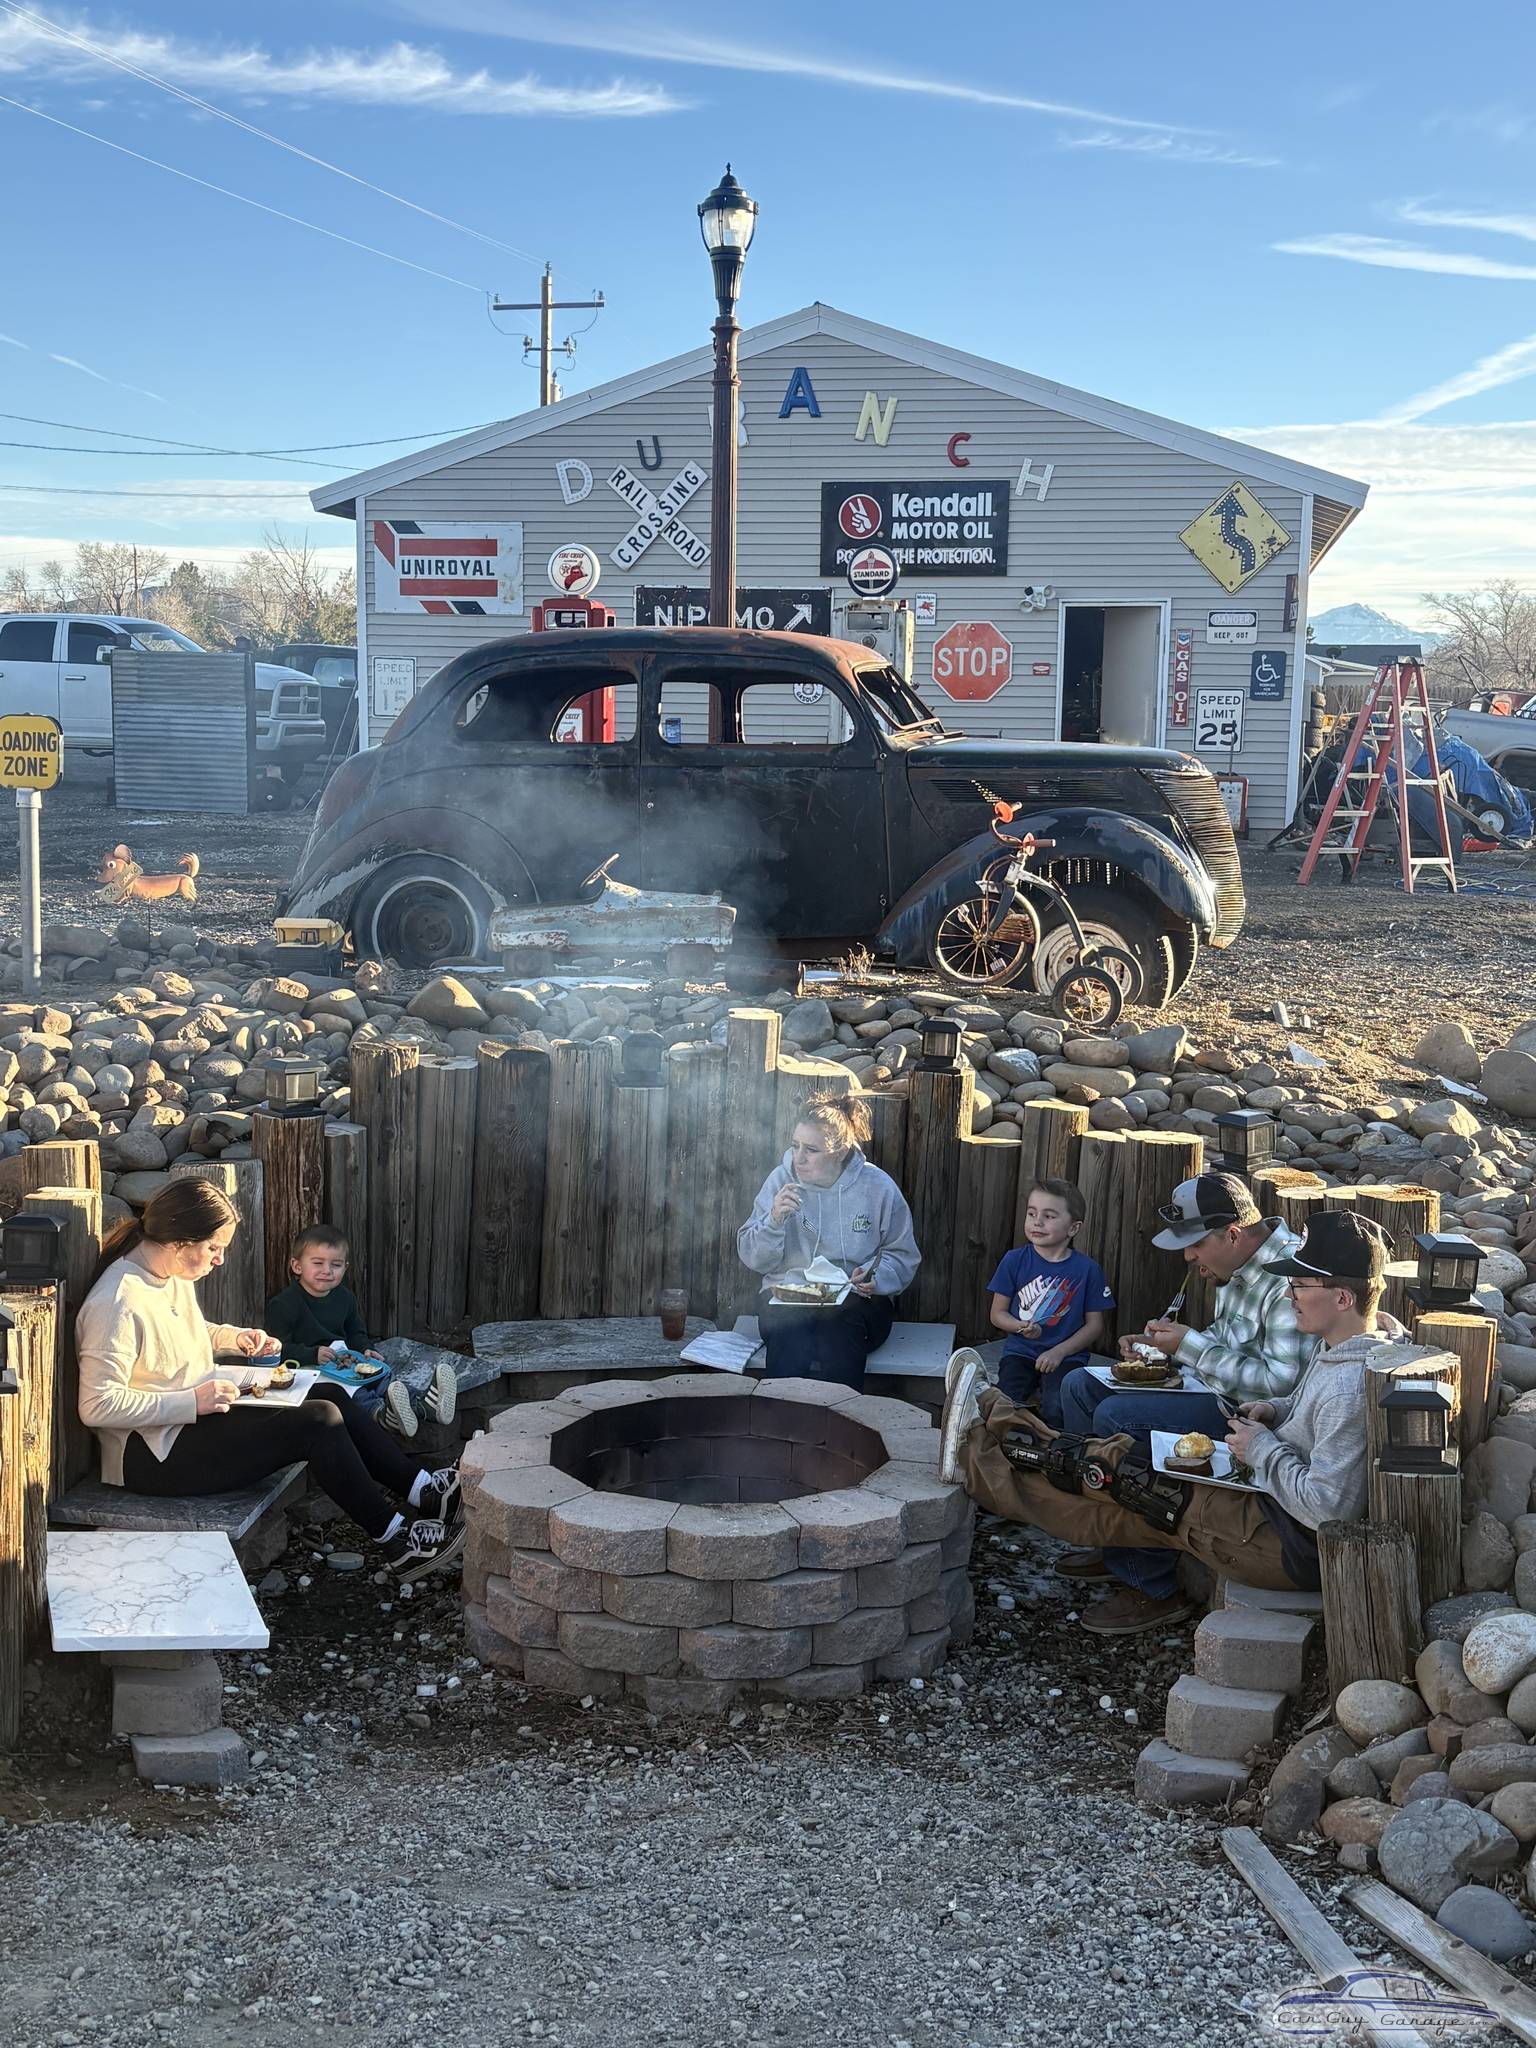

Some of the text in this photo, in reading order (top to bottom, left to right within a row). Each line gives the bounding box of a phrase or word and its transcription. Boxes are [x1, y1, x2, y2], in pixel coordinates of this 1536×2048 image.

[892, 492, 992, 518] Kendall
[611, 469, 706, 564] RAIL ROAD
[617, 470, 699, 564] CROSSING
[891, 521, 993, 539] MOTOR OIL
[893, 547, 997, 564] THE PROTECTION.
[401, 559, 495, 576] UNIROYAL
[853, 570, 890, 578] STANDARD
[654, 605, 775, 630] NIPMO
[1214, 613, 1251, 624] DANGER
[377, 664, 412, 673] SPEED
[937, 647, 1008, 677] STOP
[380, 677, 408, 685] LIMIT
[1174, 651, 1189, 723] GAS OIL
[1200, 696, 1241, 705] SPEED
[1203, 710, 1236, 719] LIMIT
[0, 731, 57, 752] OADING
[1198, 723, 1238, 746] 25
[4, 756, 49, 777] ZONE
[1018, 1274, 1044, 1309] NIKE
